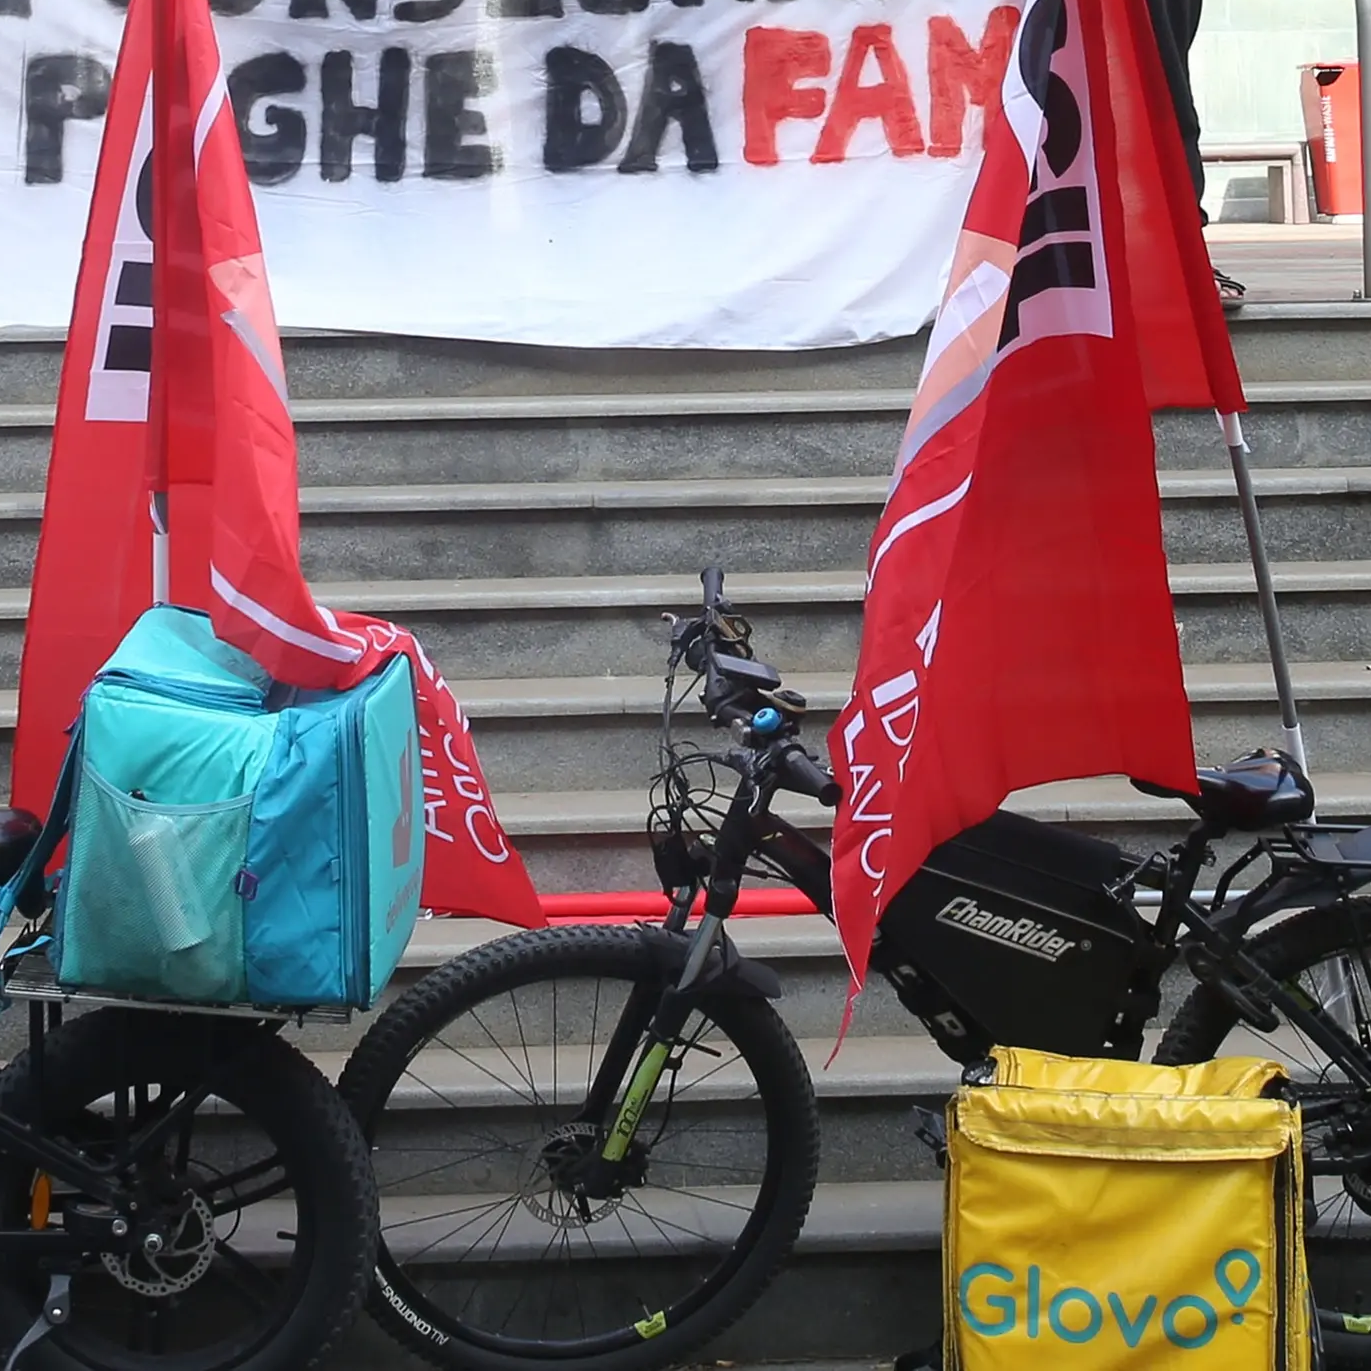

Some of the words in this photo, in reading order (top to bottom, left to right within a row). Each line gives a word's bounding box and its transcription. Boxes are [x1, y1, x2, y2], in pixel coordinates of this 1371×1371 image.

[25, 46, 503, 187] PGHE
[543, 40, 719, 175] DA
[741, 5, 1021, 166] FAM
[935, 896, 1076, 962] ChamRider
[381, 1285, 432, 1336] CONDITIONS
[958, 1261, 1219, 1350] Glovo
